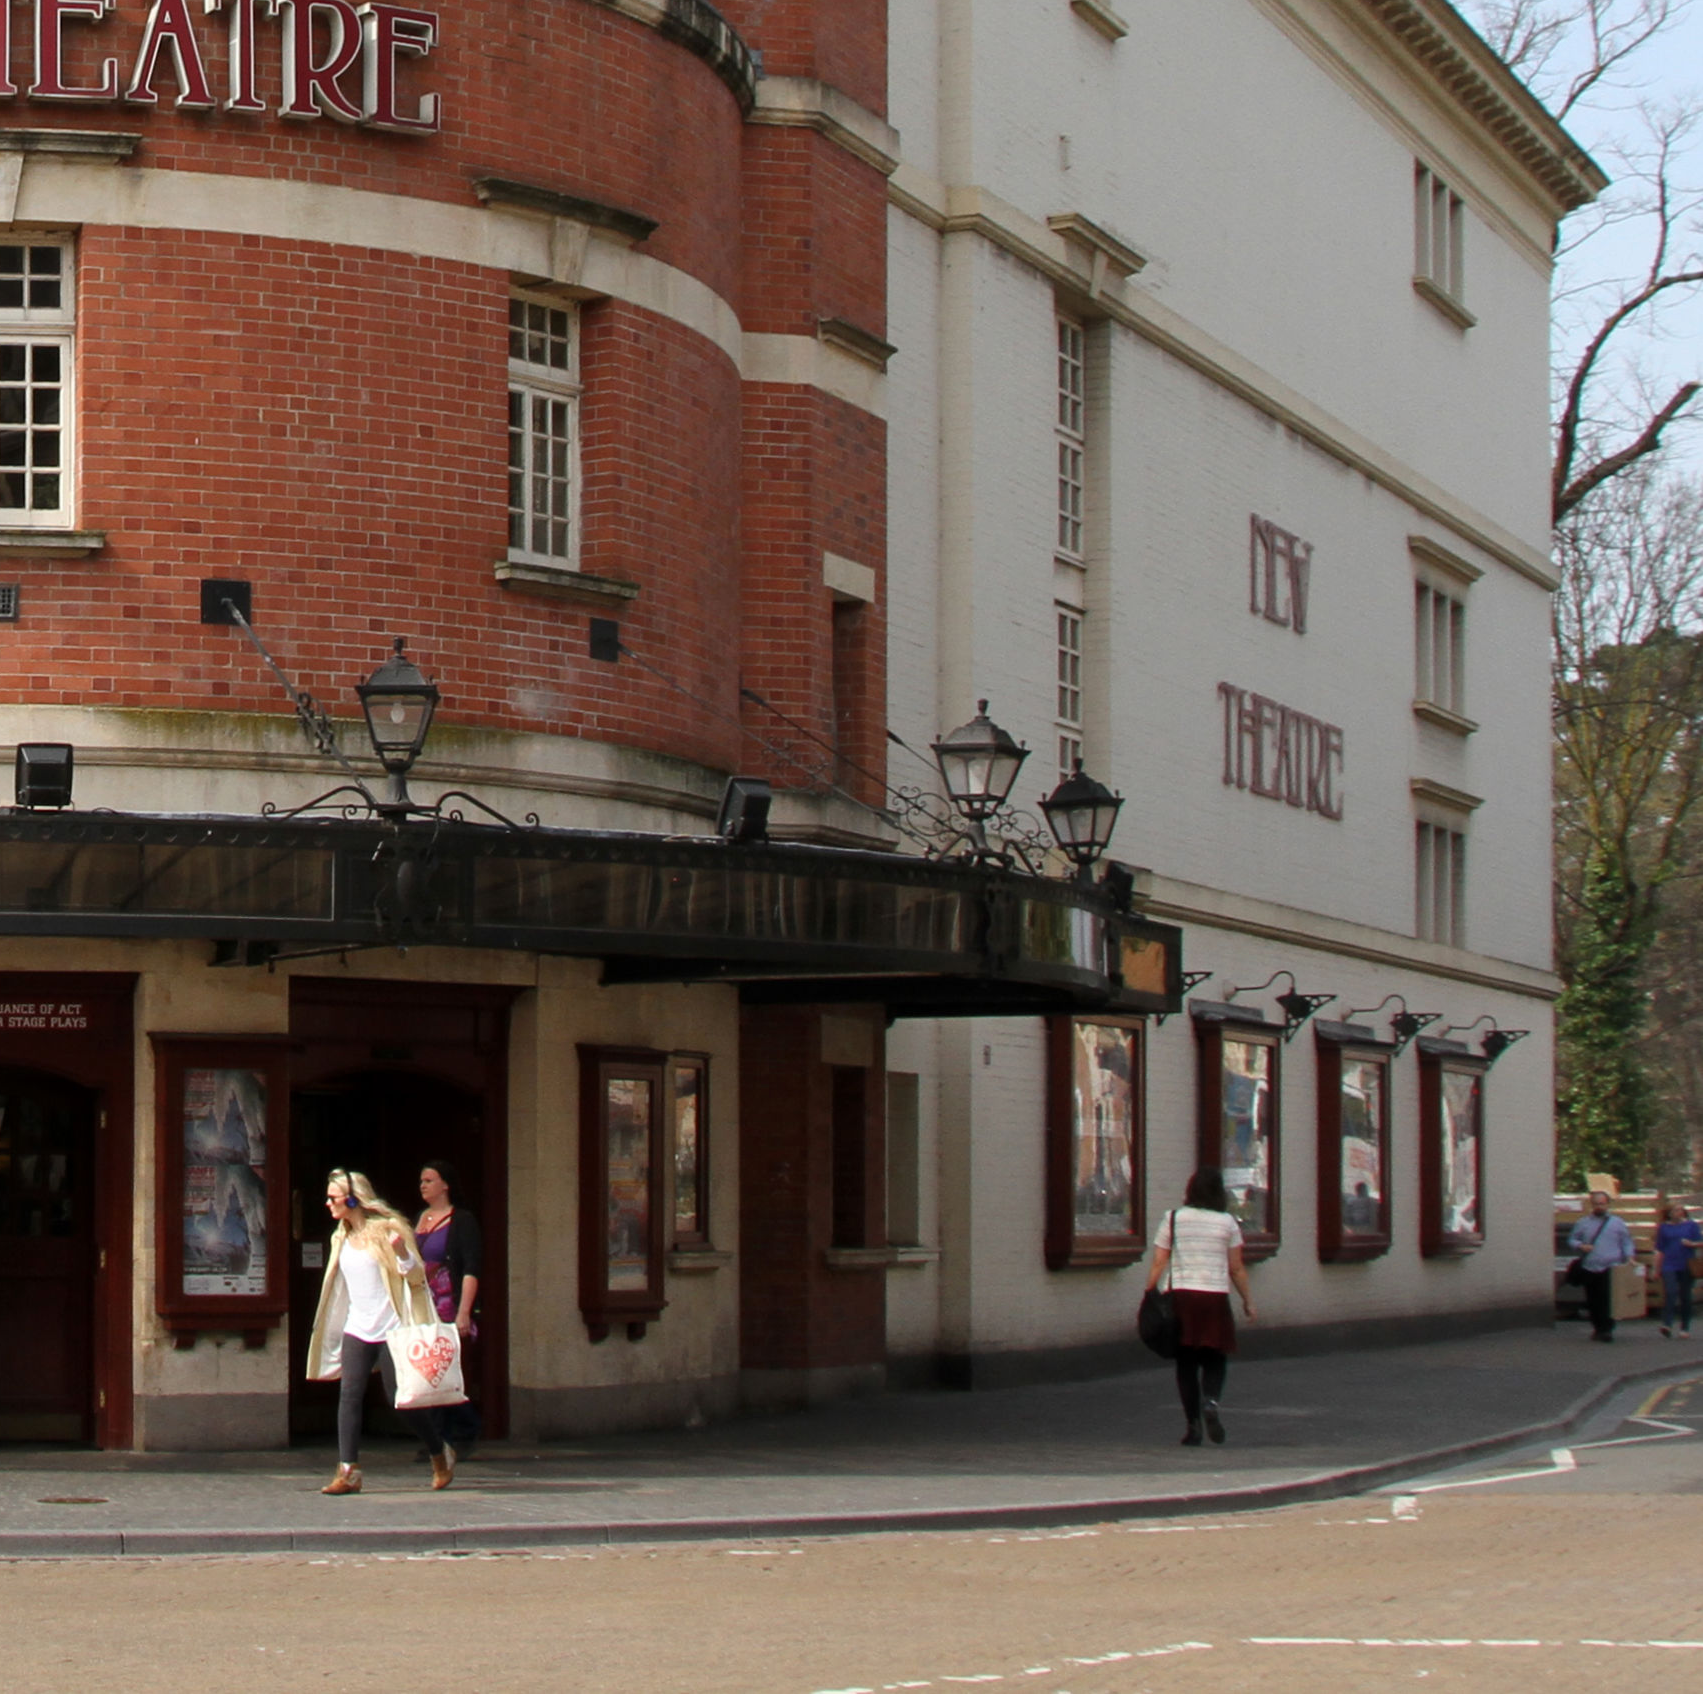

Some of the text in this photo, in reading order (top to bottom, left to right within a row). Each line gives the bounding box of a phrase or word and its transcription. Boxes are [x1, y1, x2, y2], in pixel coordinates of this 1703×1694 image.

[1249, 512, 1314, 635] NEW
[1217, 680, 1344, 822] THEATRE
[8, 1016, 46, 1028] STAGE
[50, 1017, 87, 1028] PLAYS
[39, 1004, 54, 1015] OF
[59, 1004, 82, 1015] ACT
